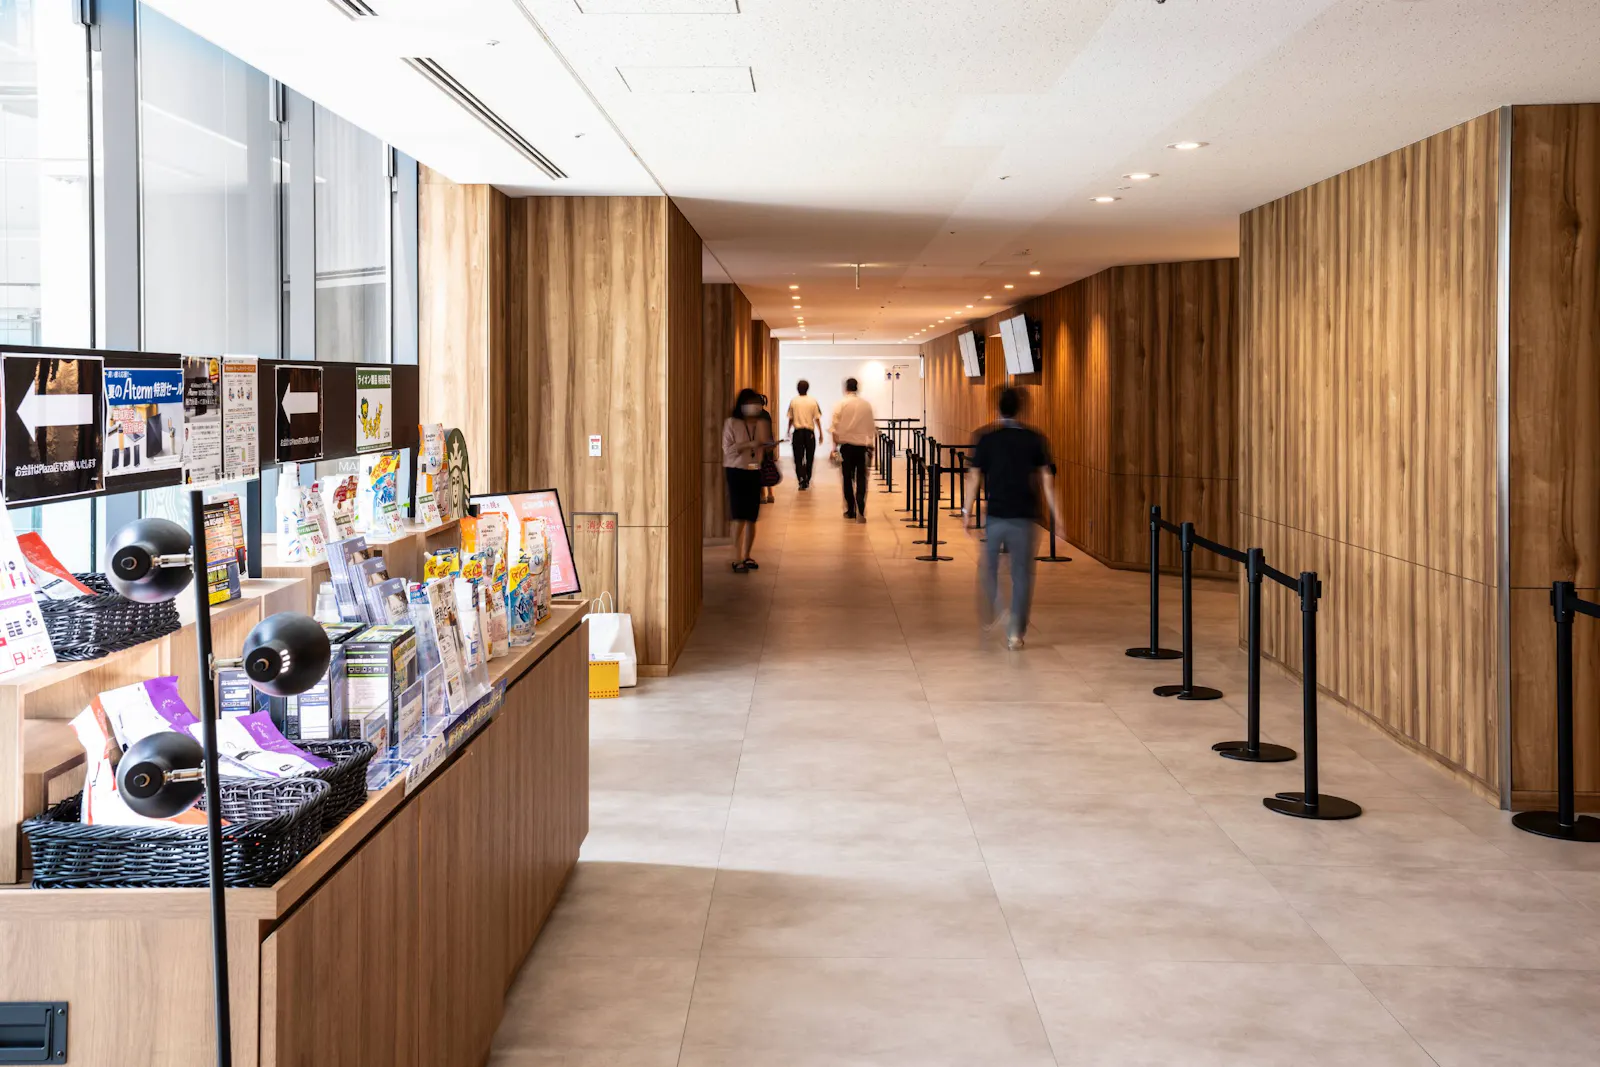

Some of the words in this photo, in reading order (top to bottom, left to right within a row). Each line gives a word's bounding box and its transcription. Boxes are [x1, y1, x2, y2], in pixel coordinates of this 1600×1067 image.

[123, 377, 152, 400] Aterm
[586, 519, 614, 529] 消火器
